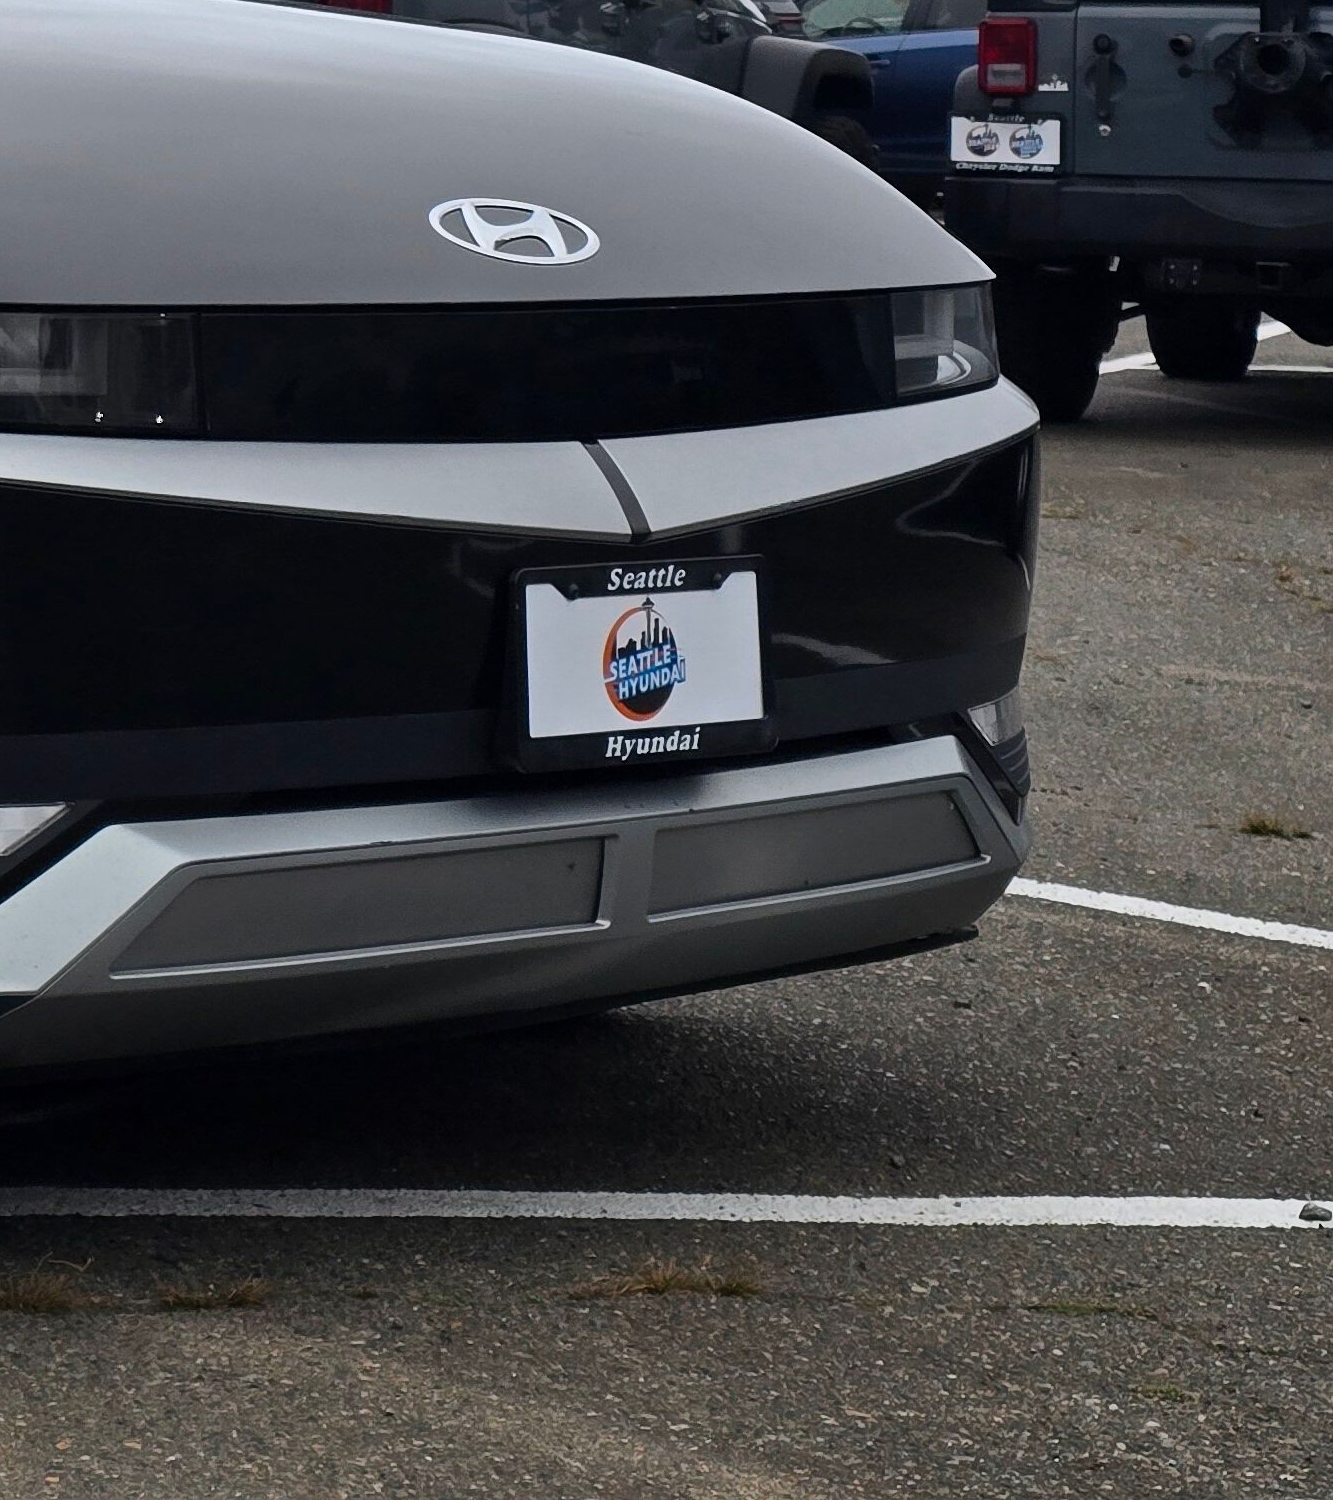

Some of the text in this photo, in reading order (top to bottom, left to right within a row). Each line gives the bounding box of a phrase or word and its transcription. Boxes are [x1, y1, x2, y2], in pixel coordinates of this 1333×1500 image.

[955, 162, 1055, 172] Chrysler Dodge Ram
[607, 564, 686, 591] Seattle
[609, 646, 671, 680] SEATTLE
[618, 661, 685, 699] HYUNDAI
[605, 727, 700, 760] Hyundai
